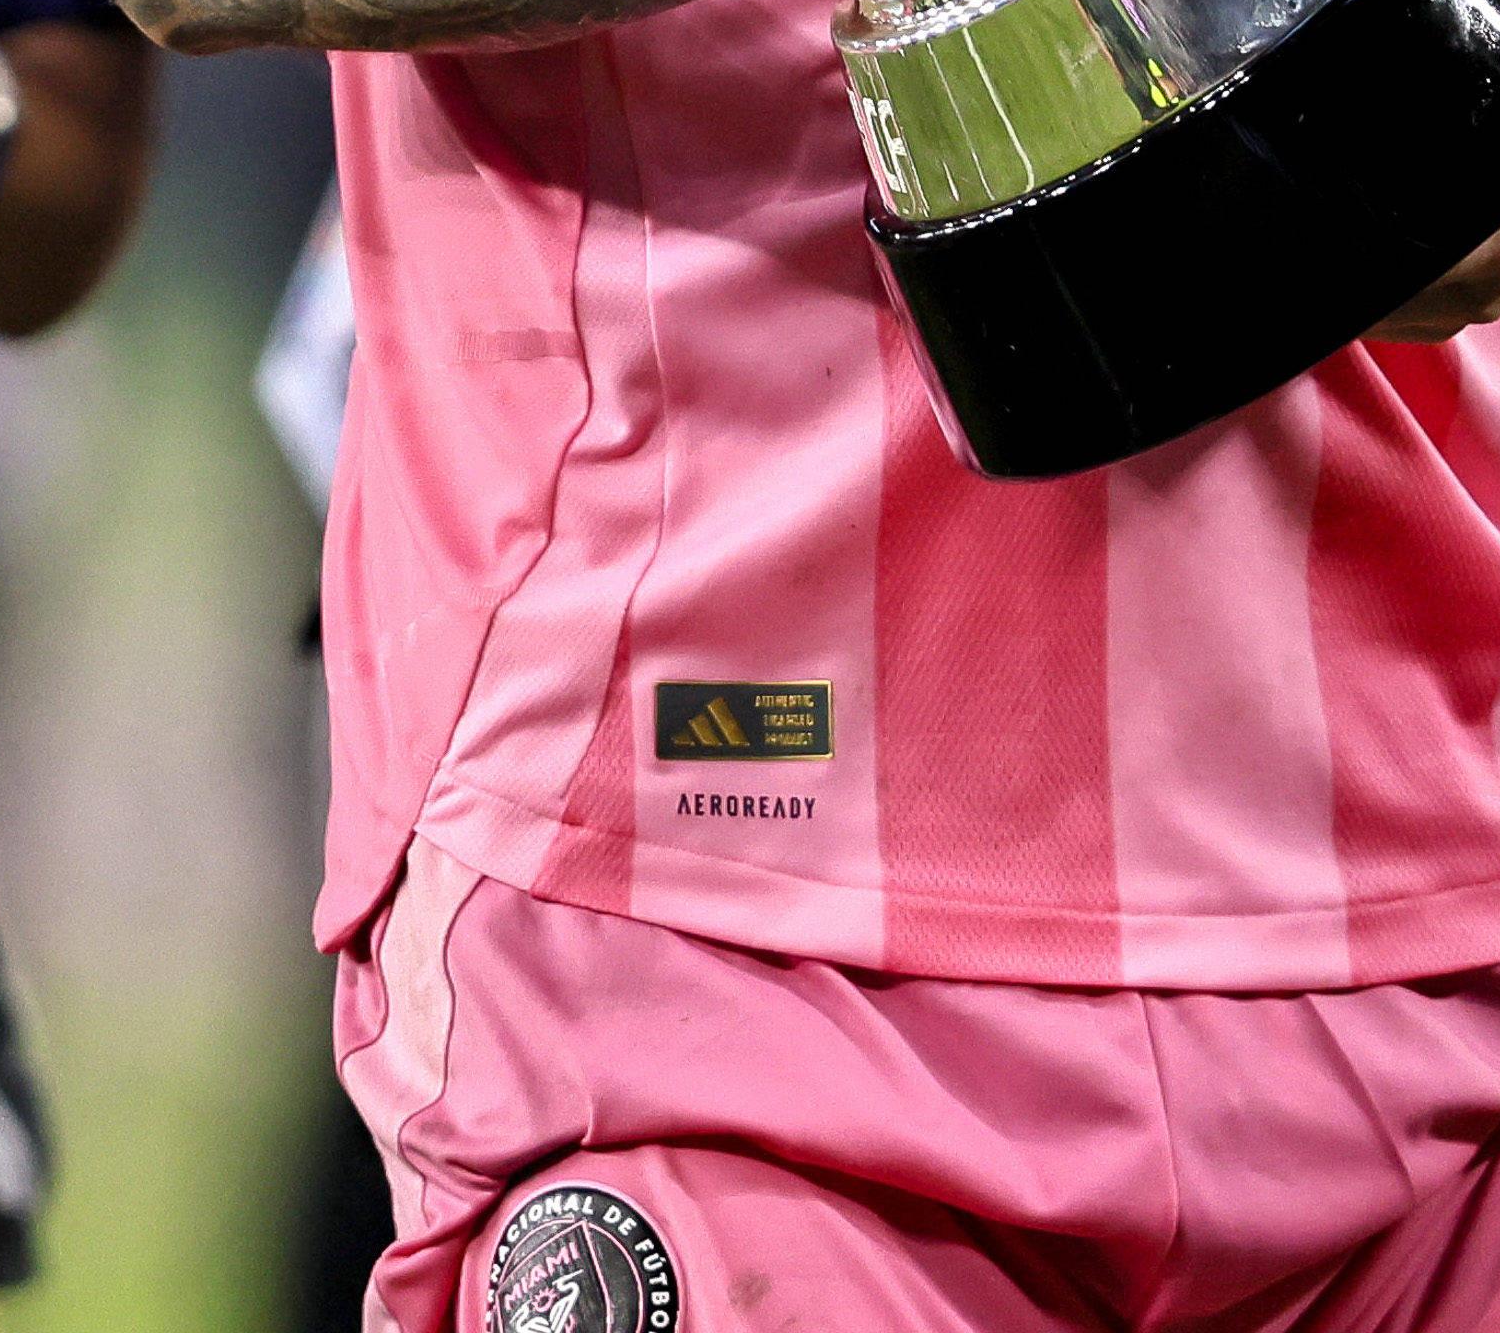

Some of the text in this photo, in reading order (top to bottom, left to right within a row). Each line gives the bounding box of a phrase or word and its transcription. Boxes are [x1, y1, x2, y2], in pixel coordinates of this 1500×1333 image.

[677, 793, 816, 819] AEROREADY
[504, 1243, 581, 1310] MIAMI
[602, 1205, 638, 1237] DE
[634, 1238, 670, 1332] FÚTBO
